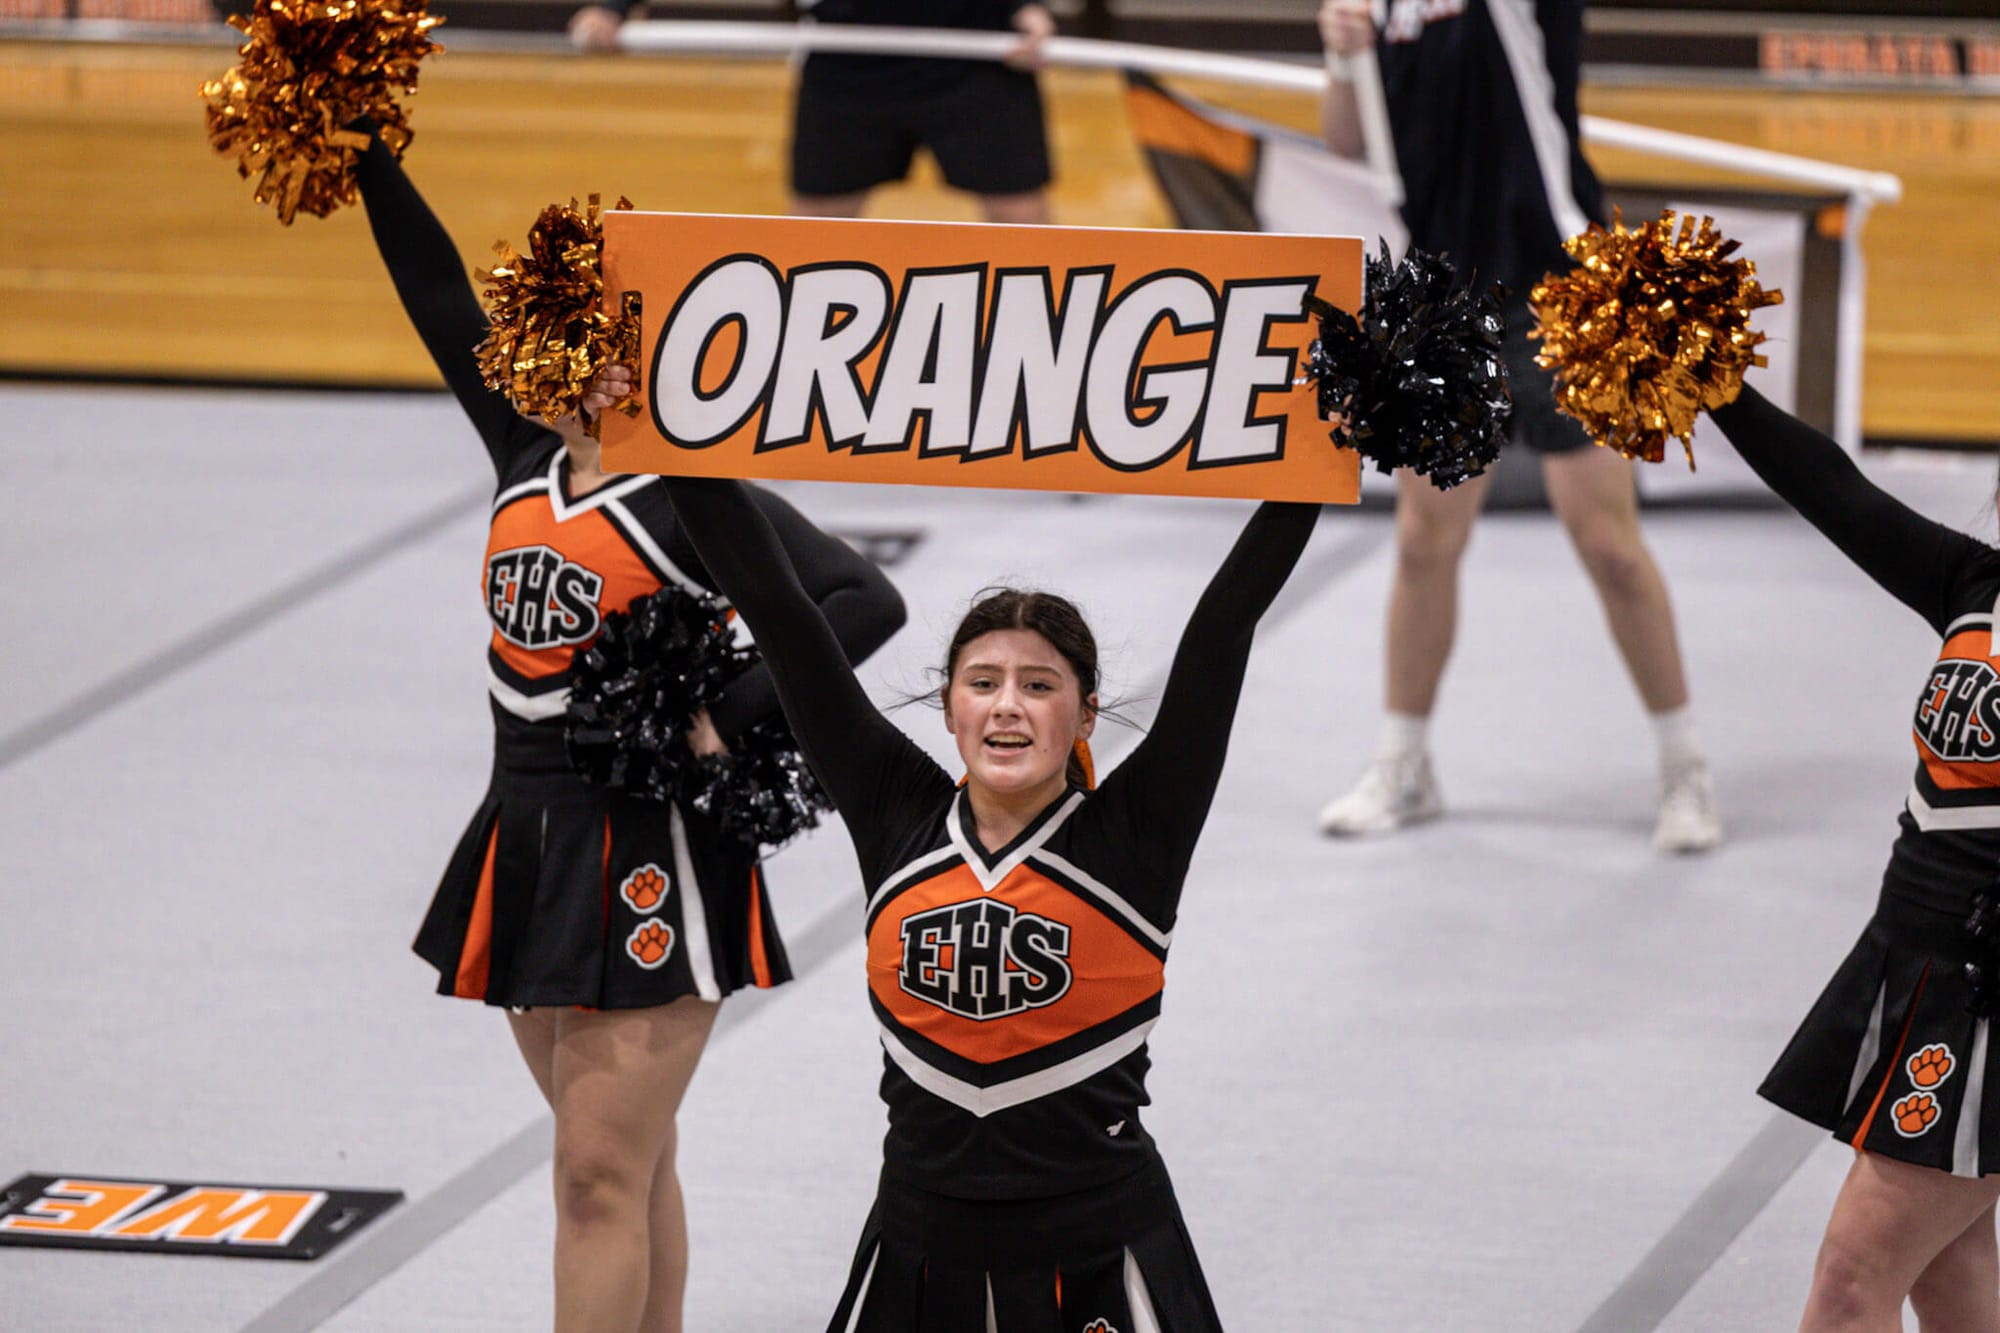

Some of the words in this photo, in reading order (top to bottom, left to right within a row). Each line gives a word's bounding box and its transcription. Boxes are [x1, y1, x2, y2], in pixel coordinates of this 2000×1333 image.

[648, 253, 1320, 472] ORANGE
[486, 545, 604, 651] EHS
[899, 897, 1074, 1021] EHS
[0, 1179, 329, 1246] WE
